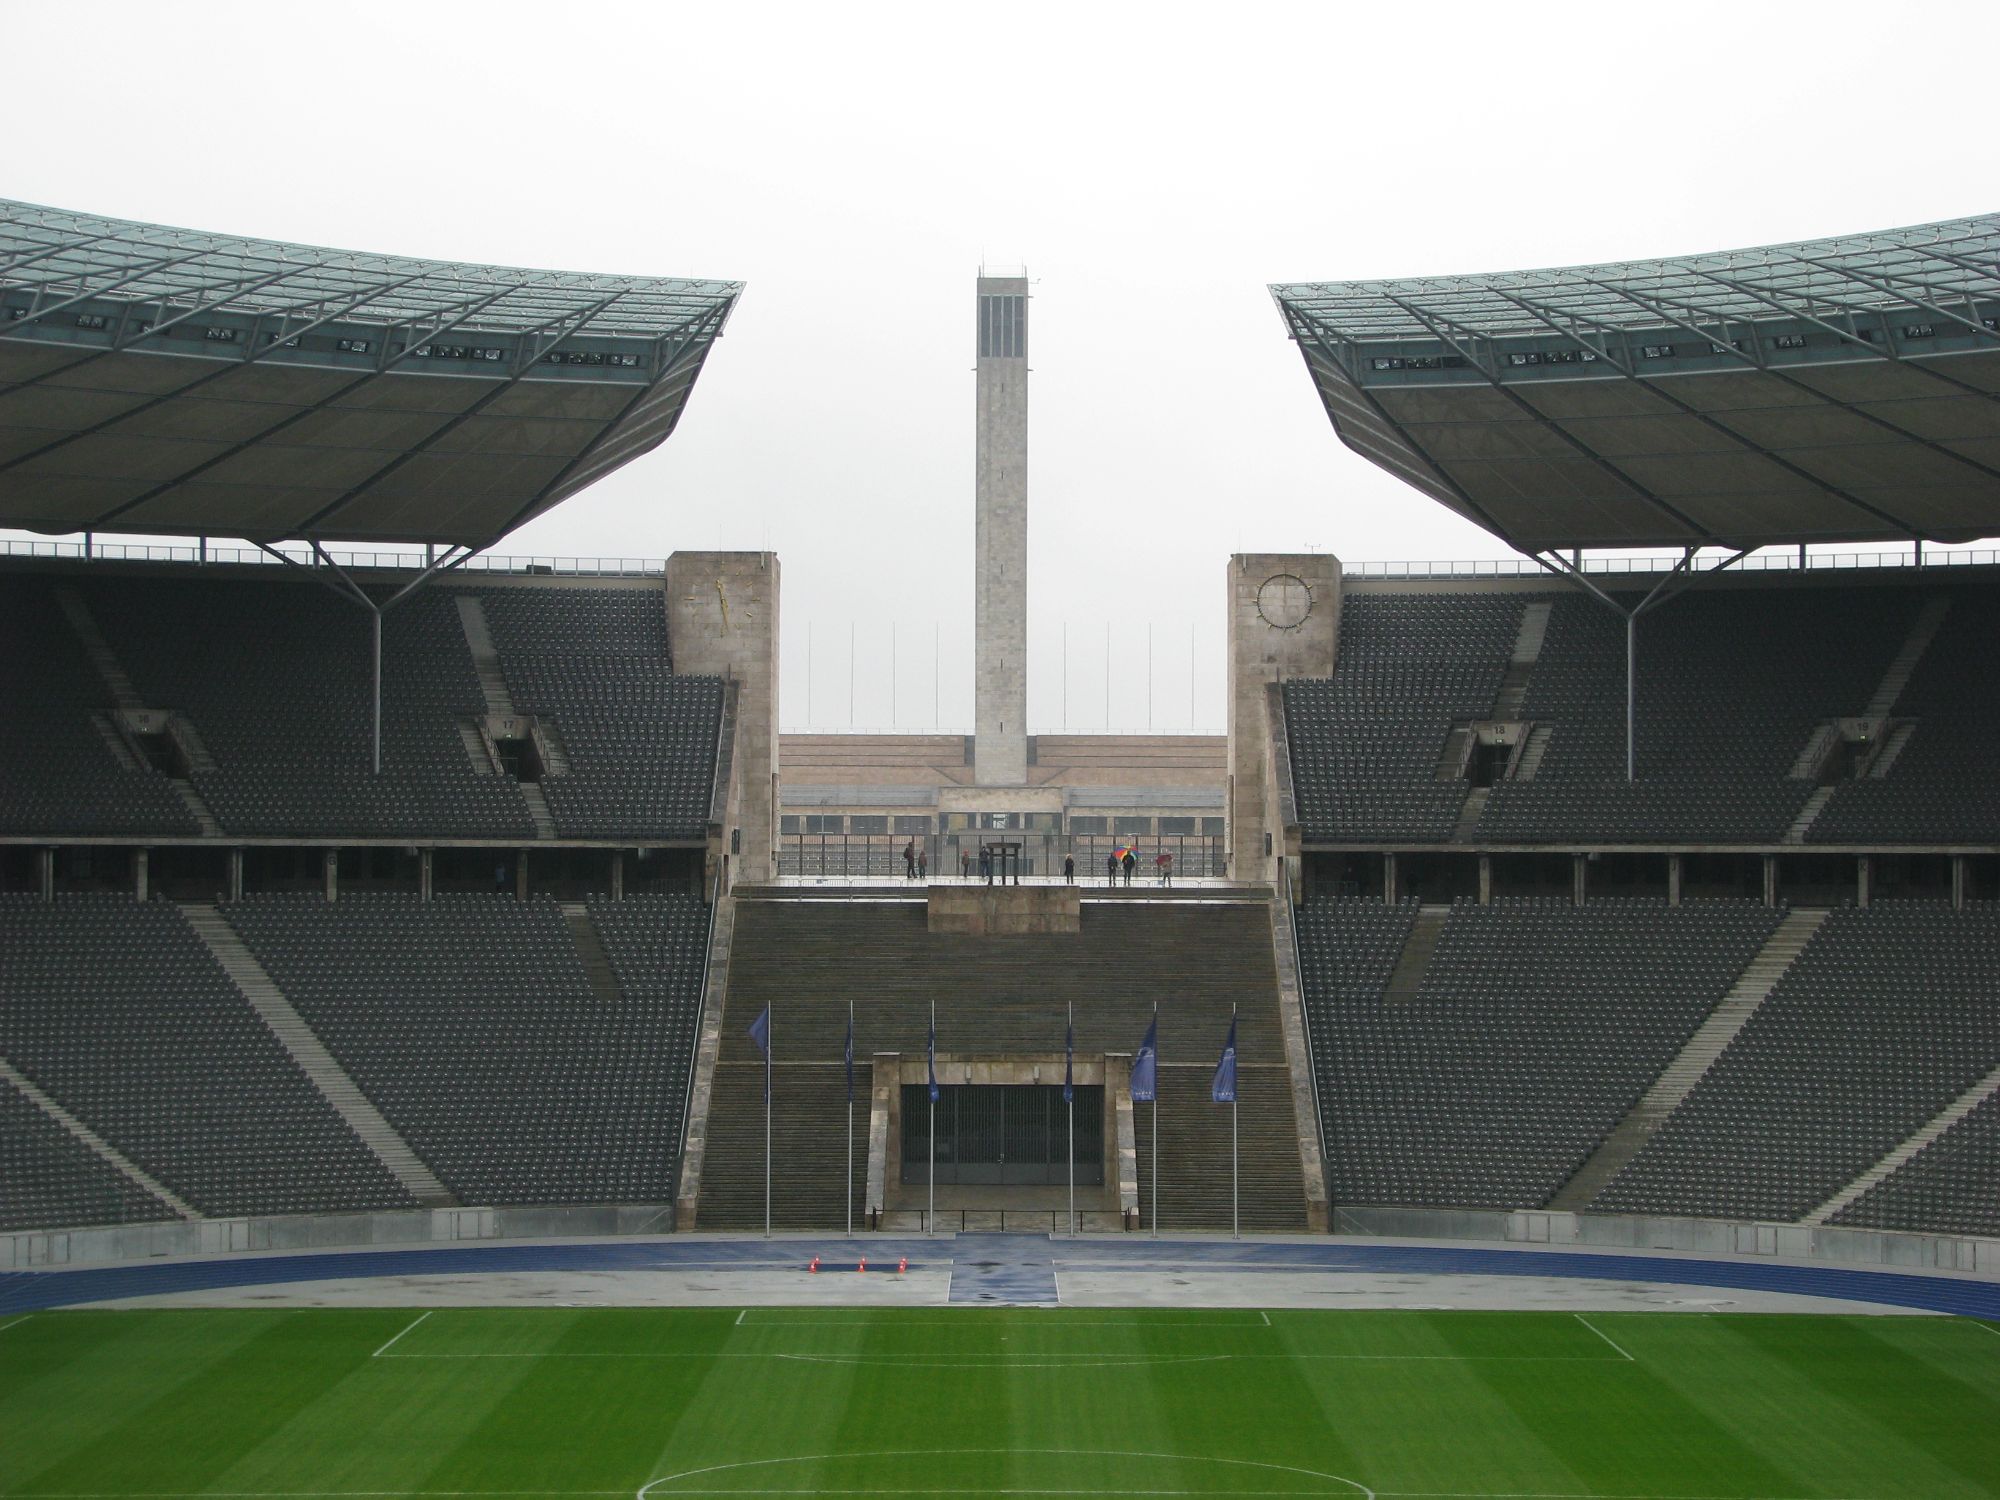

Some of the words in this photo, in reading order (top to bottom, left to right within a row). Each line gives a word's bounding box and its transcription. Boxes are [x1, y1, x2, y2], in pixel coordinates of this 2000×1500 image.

[503, 720, 514, 729] 17
[1857, 721, 1869, 732] 19
[1494, 725, 1505, 735] 18
